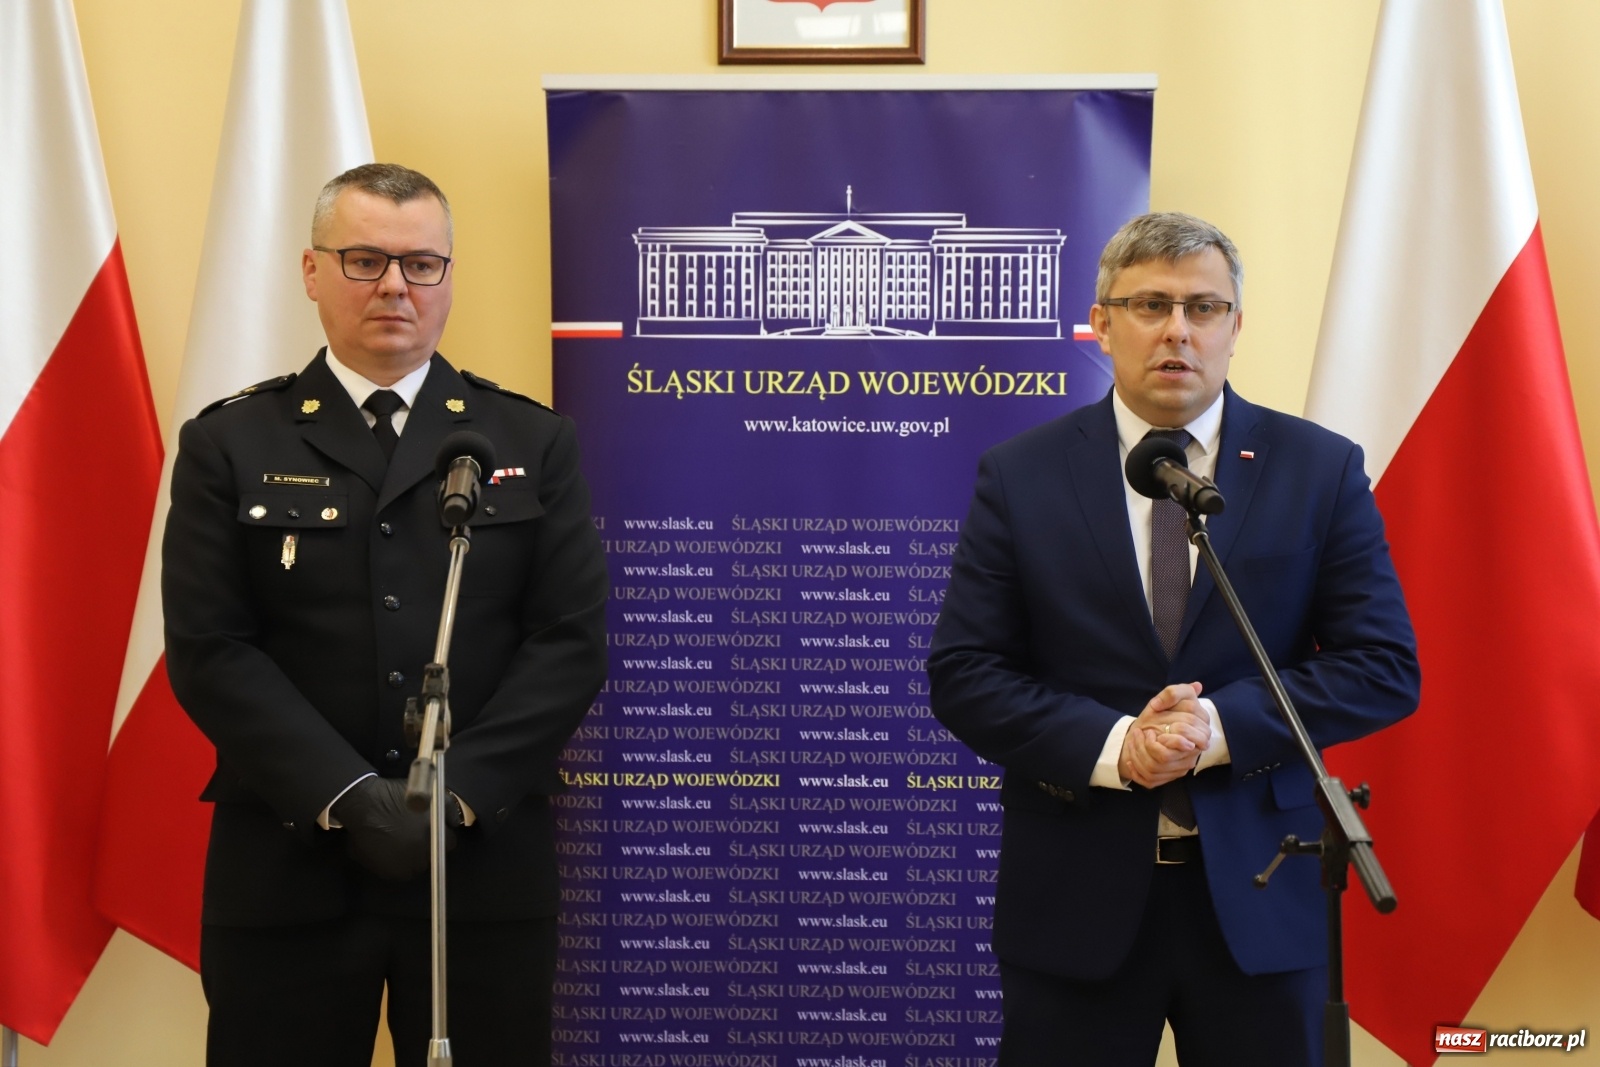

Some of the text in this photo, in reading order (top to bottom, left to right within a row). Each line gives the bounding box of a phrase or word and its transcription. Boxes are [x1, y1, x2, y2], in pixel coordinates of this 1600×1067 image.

[627, 362, 1068, 401] ŚLĄSKI URZĄD WOJEWÓDZKI
[744, 416, 950, 437] www.katowice.uw.gov.pl
[624, 517, 713, 530] www.slask.eu
[732, 514, 787, 533] ŚLĄSKI
[793, 518, 847, 534] URZĄD
[852, 516, 958, 532] WOJEWÓDZKI
[615, 540, 670, 556] URZĄD
[675, 538, 781, 554] WOJEWÓDZKI
[801, 542, 890, 554] www.slask.eu
[909, 539, 958, 558] ŚLĄSK
[624, 561, 952, 580] www.slask.eu ŚLĄSKI URZĄD WOJEWÓDZK
[615, 584, 946, 605] URZĄD WOJEWÓDZKI www.slask.eu ŚLĄS
[624, 608, 940, 627] www.slask.eu ŚLĄSKI URZĄD WOJEWÓDZ
[615, 634, 670, 649] URZĄD
[674, 631, 780, 647] WOJEWÓDZKI
[800, 635, 889, 647] www.slask.eu
[623, 654, 927, 674] www.slask.eu ŚLĄSKI URZĄD WOJEWÓD
[614, 680, 669, 696] URZĄD
[673, 678, 780, 693] WOJEWÓDZKI
[800, 681, 889, 694] www.slask.eu
[623, 701, 935, 720] www.slask.eu ŚLĄSKI URZĄD WOJEWÓD
[573, 724, 961, 745] ĄSKI URZĄD WOJEWÓDZKI www.slask.eu ŚLĄSK
[622, 750, 711, 762] www.slask.eu
[730, 747, 785, 766] ŚLĄSKI
[791, 751, 846, 767] URZĄD
[850, 749, 957, 765] WOJEWÓDZKI
[613, 773, 669, 789] URZĄD
[672, 771, 779, 786] WOJEWÓDZKI
[799, 774, 888, 787] www.slask.eu
[907, 772, 963, 791] ŚLĄSKI
[968, 776, 1002, 789] URZ
[622, 796, 711, 809] www.slask.eu
[730, 794, 785, 813] ŚLĄSKI
[790, 798, 845, 813] URZĄD
[849, 796, 956, 811] WOJEWÓDZKI
[556, 816, 1002, 838] ŚLĄSKI URZĄD WOJEWÓDZKI www.slask.eu ŚLĄSKI URZ
[621, 843, 710, 856] www.slask.eu
[729, 841, 785, 859] ŚLĄSKI
[790, 844, 845, 860] URZĄD
[849, 842, 956, 858] WOJEWÓDZKI
[613, 867, 668, 882] URZĄD
[672, 864, 779, 880] WOJEWÓDZKI
[799, 868, 888, 881] www.slask.eu
[906, 866, 962, 885] ŚLĄSKI
[967, 870, 999, 882] URZ
[621, 887, 956, 907] www.slask.eu ŚLĄSKI URZĄD WOJEWÓDZKI
[612, 913, 667, 929] URZĄD
[671, 911, 778, 927] WOJEWÓDZKI
[798, 915, 887, 927] www.slask.eu
[906, 913, 962, 931] ŚLĄSKI
[966, 916, 994, 929] URZ
[620, 934, 955, 953] www.slask.eu ŚLĄSKI URZĄD WOJEWÓDZKI
[611, 960, 667, 976] URZĄD
[670, 958, 778, 973] WOJEWÓDZKI
[798, 961, 887, 974] www.slask.eu
[906, 959, 961, 978] ŚLĄSKI
[967, 963, 1000, 976] URZ
[620, 983, 709, 996] www.slask.eu
[728, 981, 783, 999] ŚLĄSKI
[789, 985, 844, 1000] URZĄD
[848, 983, 955, 999] WOJEWÓDZKI
[611, 1007, 666, 1023] URZĄD
[670, 1004, 777, 1020] WOJEWÓDZKI
[797, 1008, 886, 1021] www.slask.eu
[905, 1007, 961, 1025] ŚLĄSKI
[966, 1010, 1002, 1023] URZ
[619, 1030, 709, 1043] www.slask.eu
[728, 1028, 783, 1047] ŚLĄSKI
[788, 1032, 844, 1048] URZĄD
[847, 1030, 955, 1046] WOJEWÓDZKI
[670, 1052, 777, 1067] WOJEWÓDZKI
[797, 1055, 886, 1067] www.slask.eu
[966, 1058, 998, 1067] URZ
